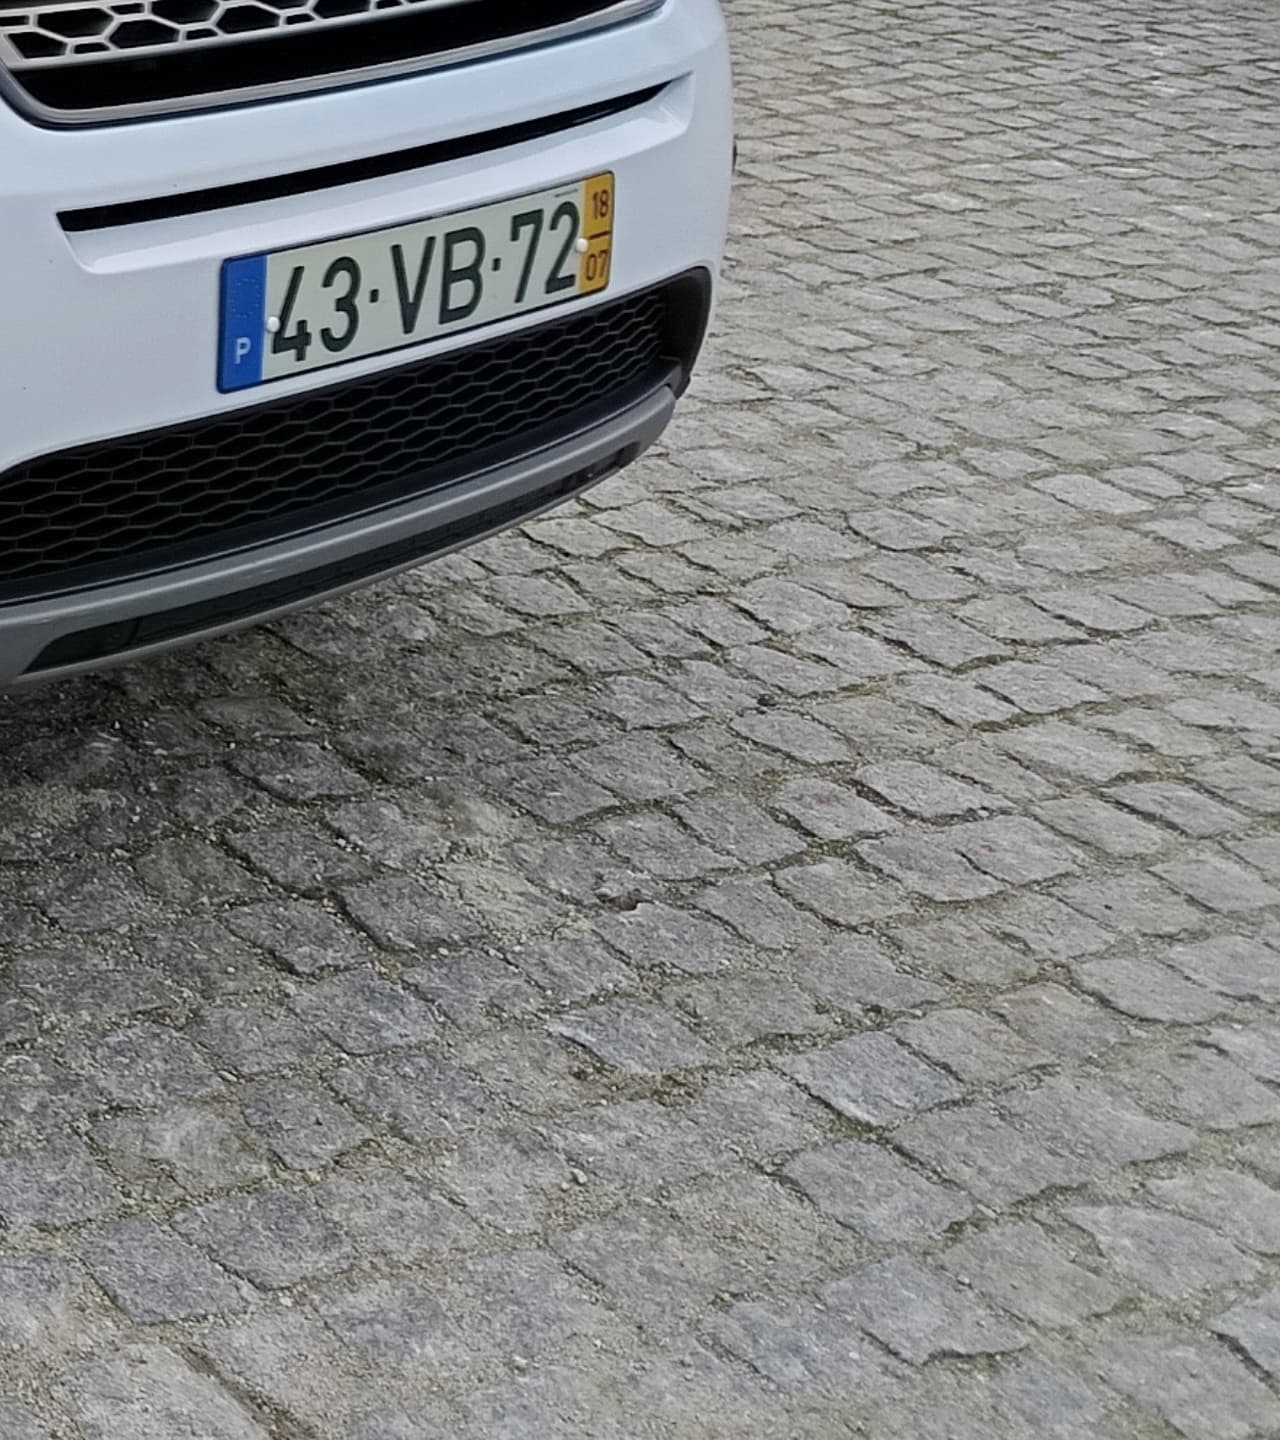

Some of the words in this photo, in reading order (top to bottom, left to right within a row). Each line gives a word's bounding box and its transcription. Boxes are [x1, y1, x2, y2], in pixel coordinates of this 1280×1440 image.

[592, 189, 610, 221] 18
[584, 247, 609, 283] 07
[234, 337, 252, 365] P
